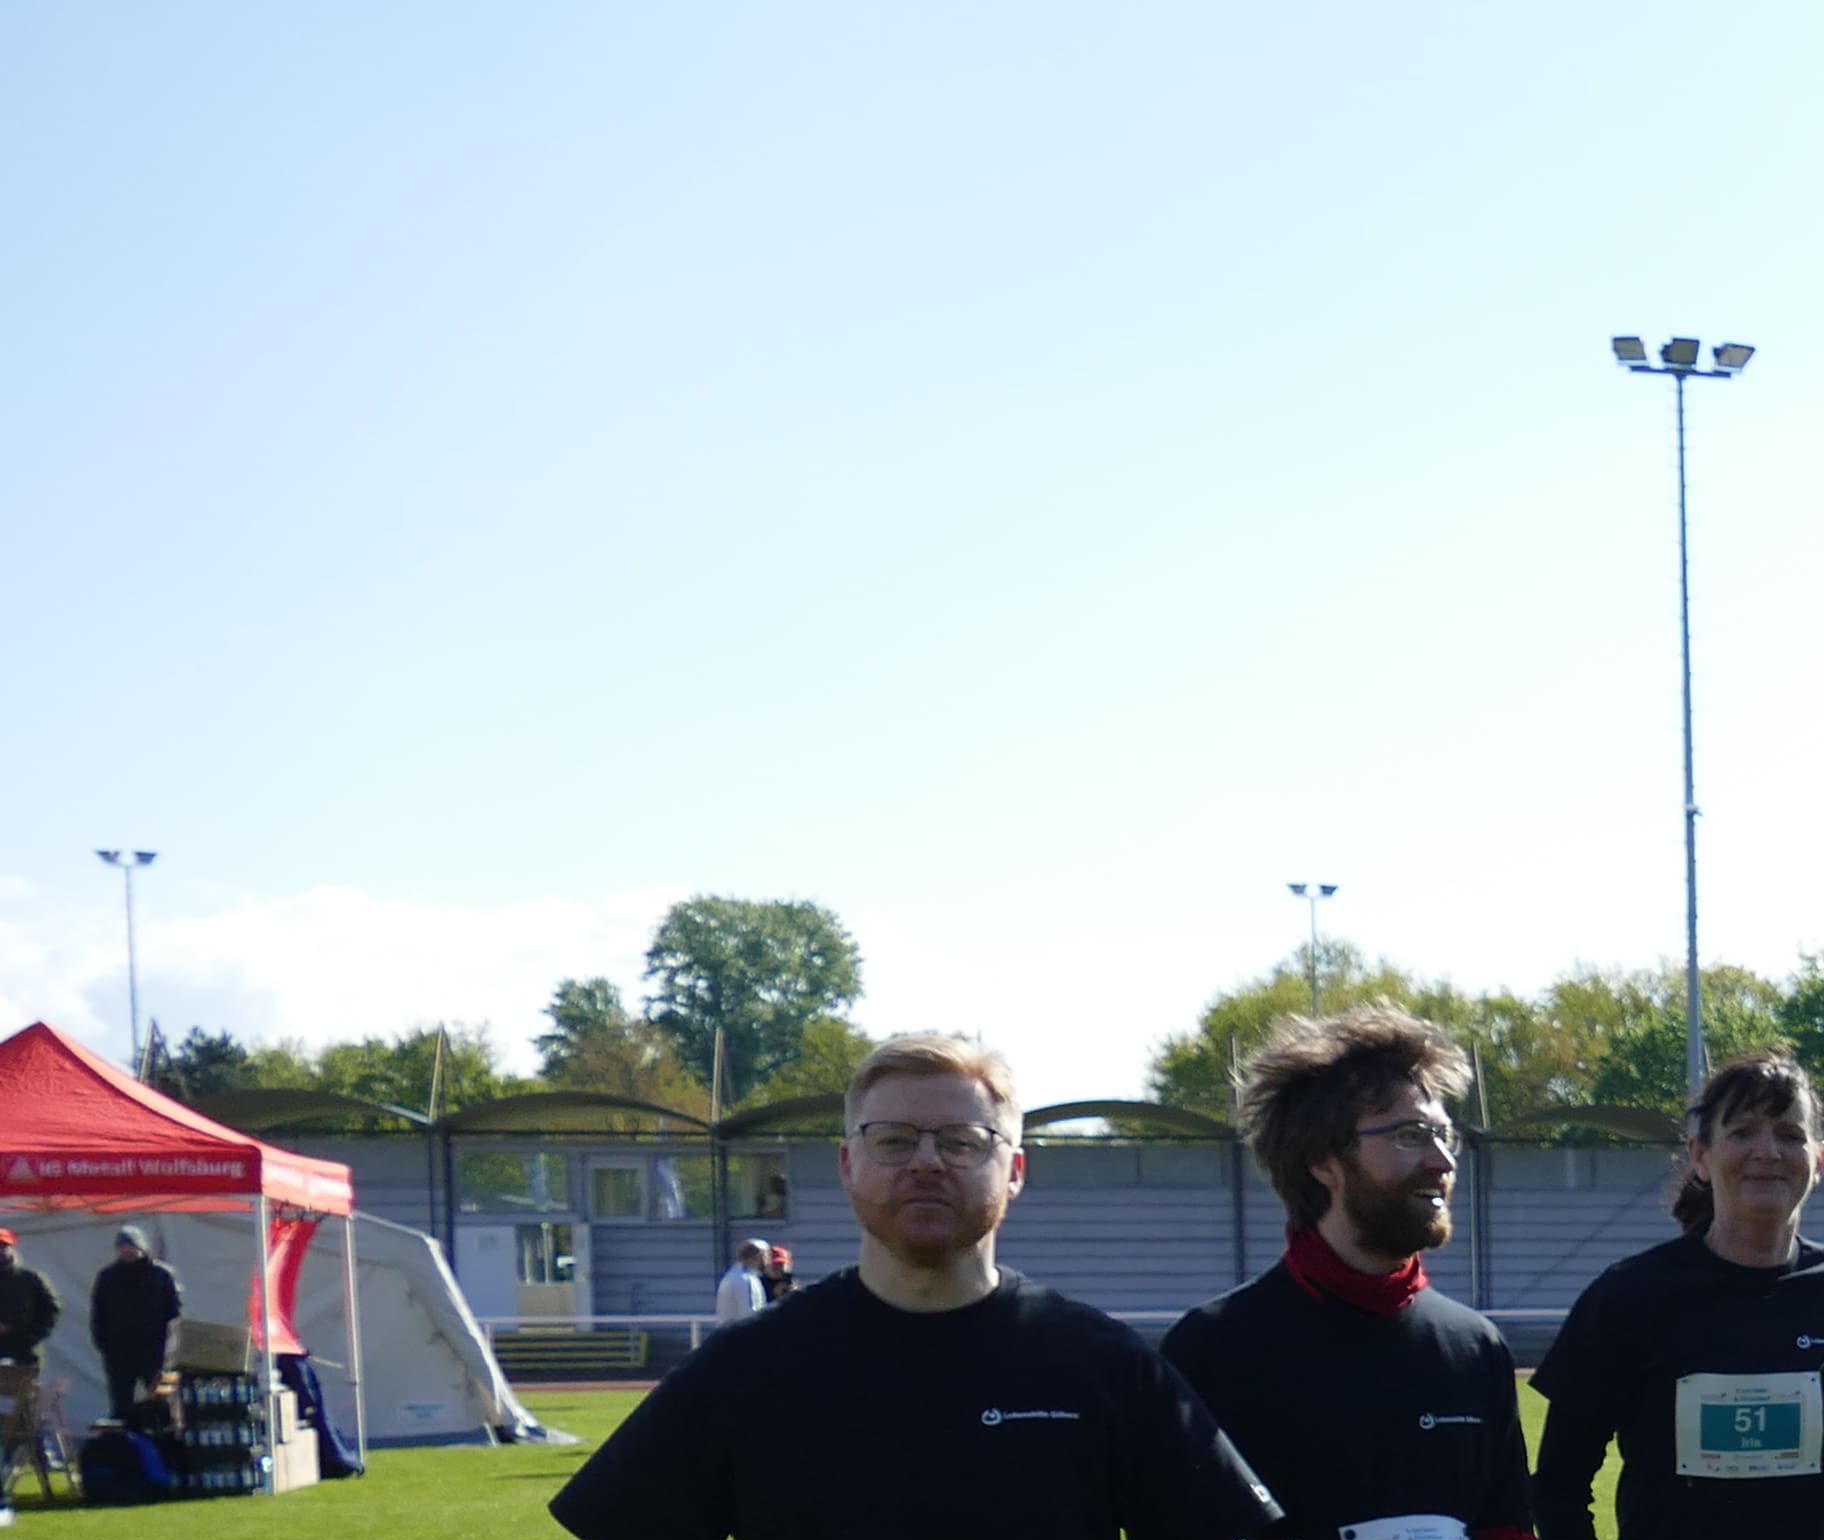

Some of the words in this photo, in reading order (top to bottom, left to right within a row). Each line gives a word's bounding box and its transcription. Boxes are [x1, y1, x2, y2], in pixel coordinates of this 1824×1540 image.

[67, 1158, 134, 1177] Metall
[139, 1158, 246, 1179] Wolfsburg
[1734, 1406, 1767, 1433] 51
